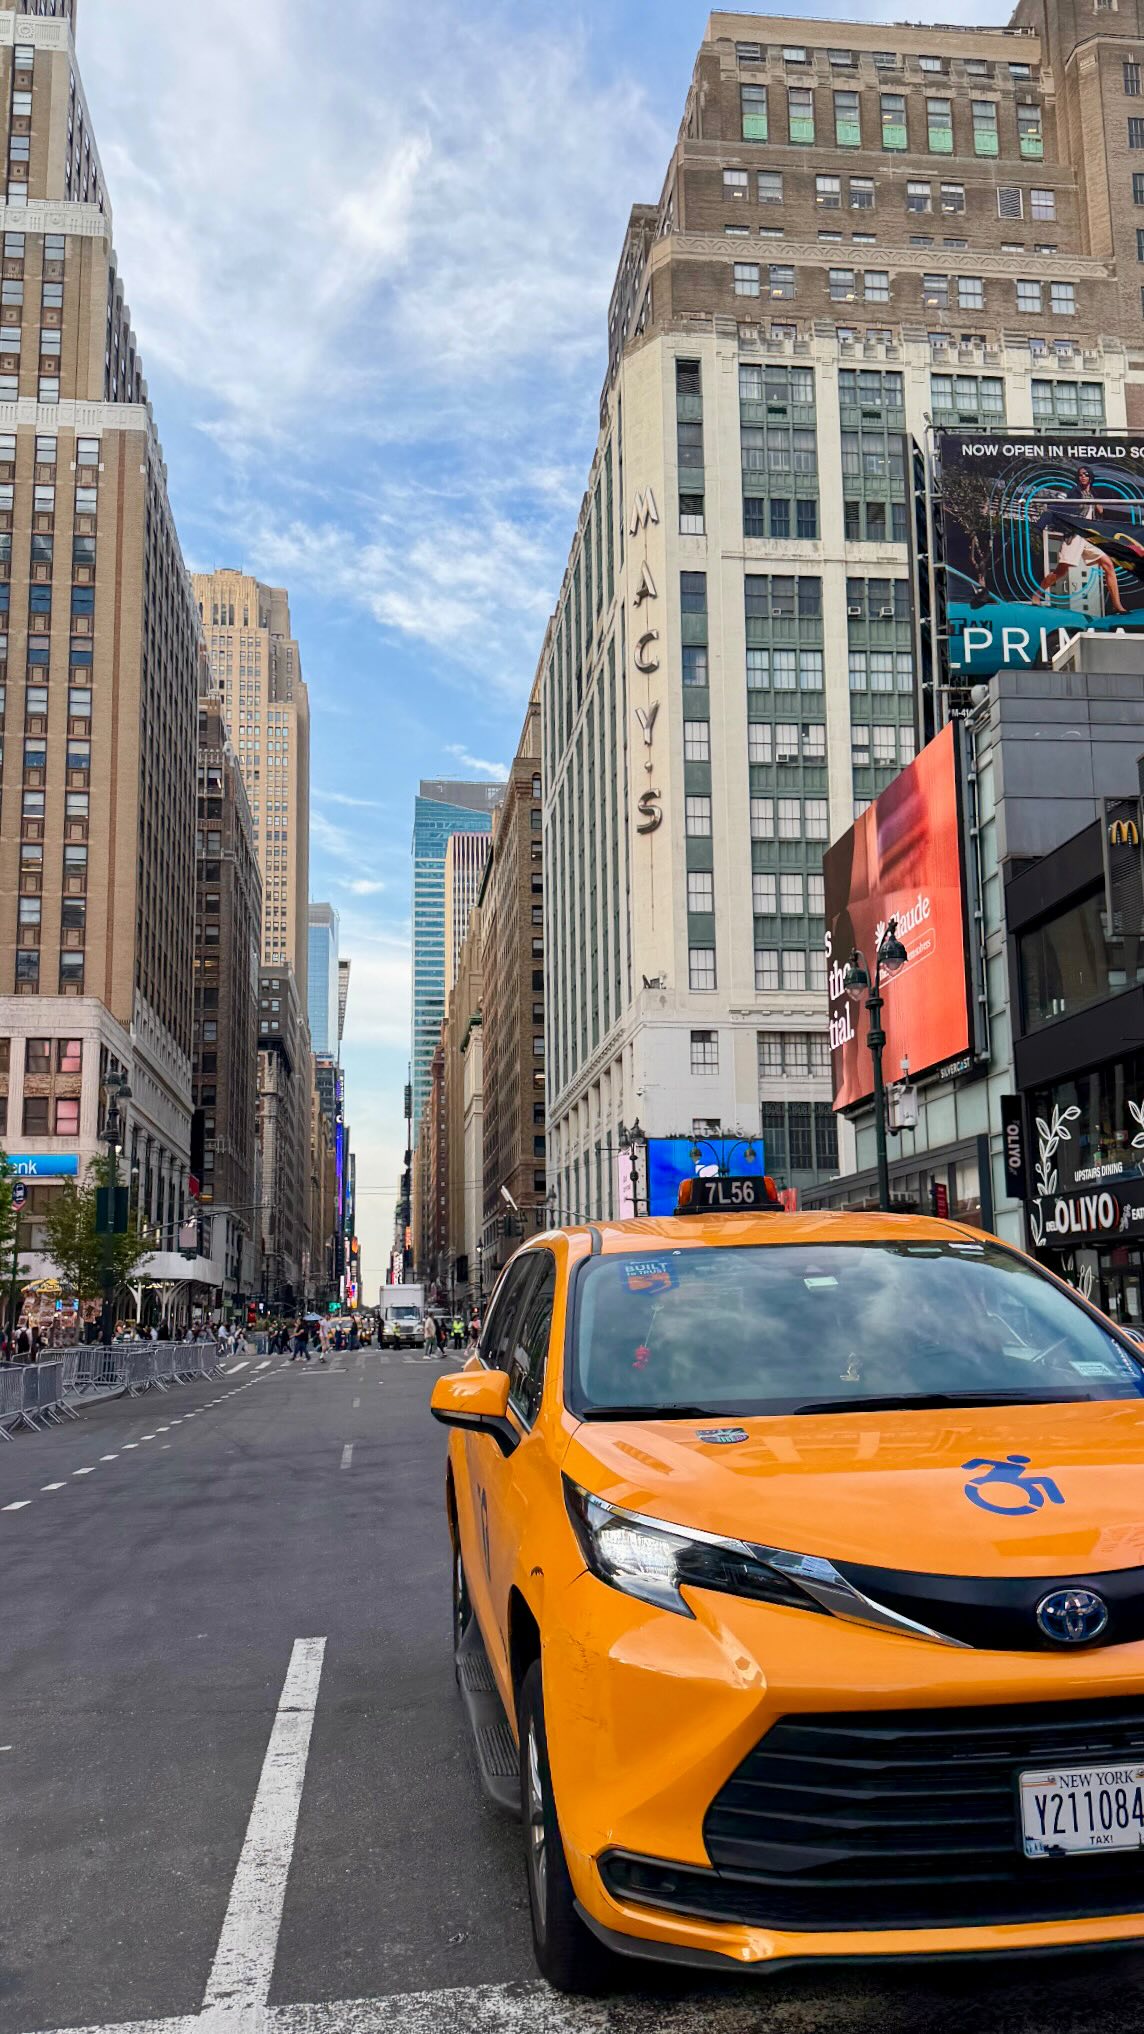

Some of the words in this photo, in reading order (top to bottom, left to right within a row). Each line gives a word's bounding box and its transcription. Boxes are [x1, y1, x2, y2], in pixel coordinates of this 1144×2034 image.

[962, 444, 999, 457] NOW
[1002, 444, 1044, 457] OPEN
[1048, 445, 1064, 457] IN
[1067, 446, 1126, 459] HERALD
[1074, 1166, 1101, 1182] UPSTAIRS
[1101, 1161, 1123, 1177] DINING
[705, 1181, 755, 1205] 7L56
[625, 1262, 668, 1273] BUILT
[1059, 1772, 1092, 1789] NEW
[1095, 1769, 1135, 1786] YORK
[1034, 1787, 1144, 1836] Y211084
[1090, 1834, 1114, 1846] TAXI
